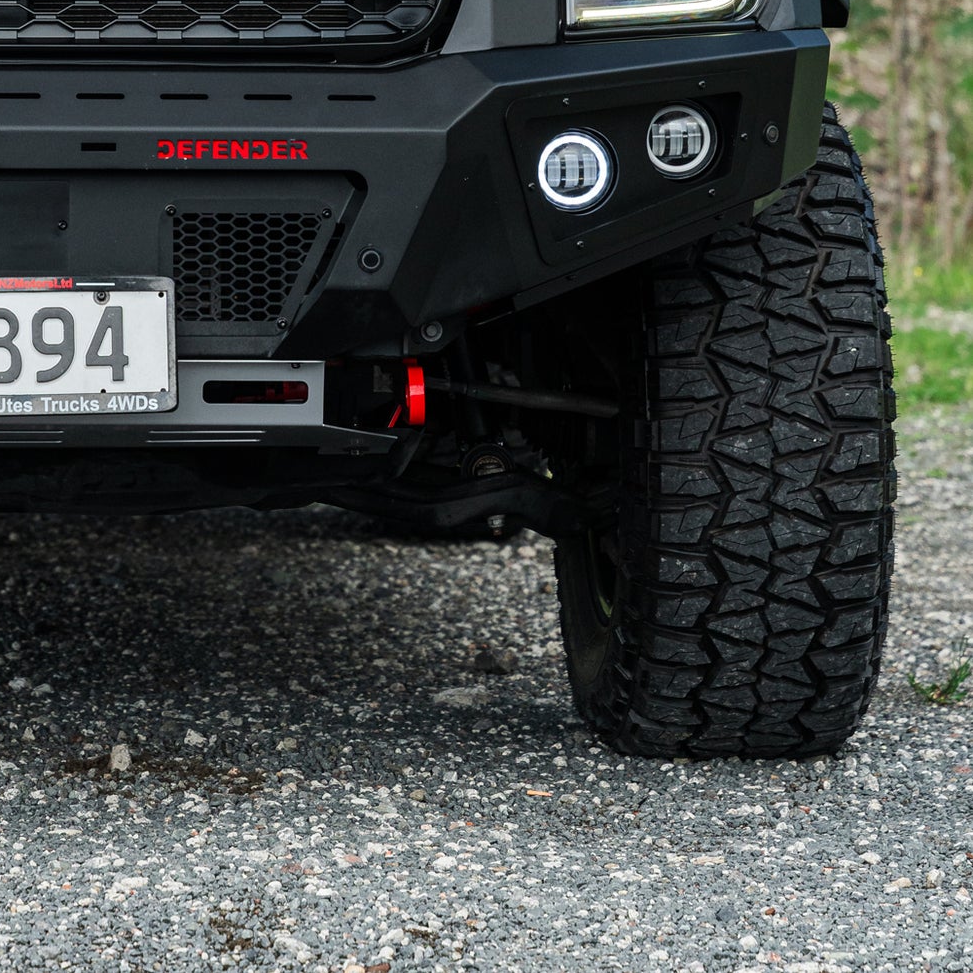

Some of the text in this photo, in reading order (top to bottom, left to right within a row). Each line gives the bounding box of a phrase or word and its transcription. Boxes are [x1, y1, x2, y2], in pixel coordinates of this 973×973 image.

[157, 139, 308, 160] DEFENDER
[41, 396, 100, 412] Trucks
[107, 395, 159, 411] 4WDs
